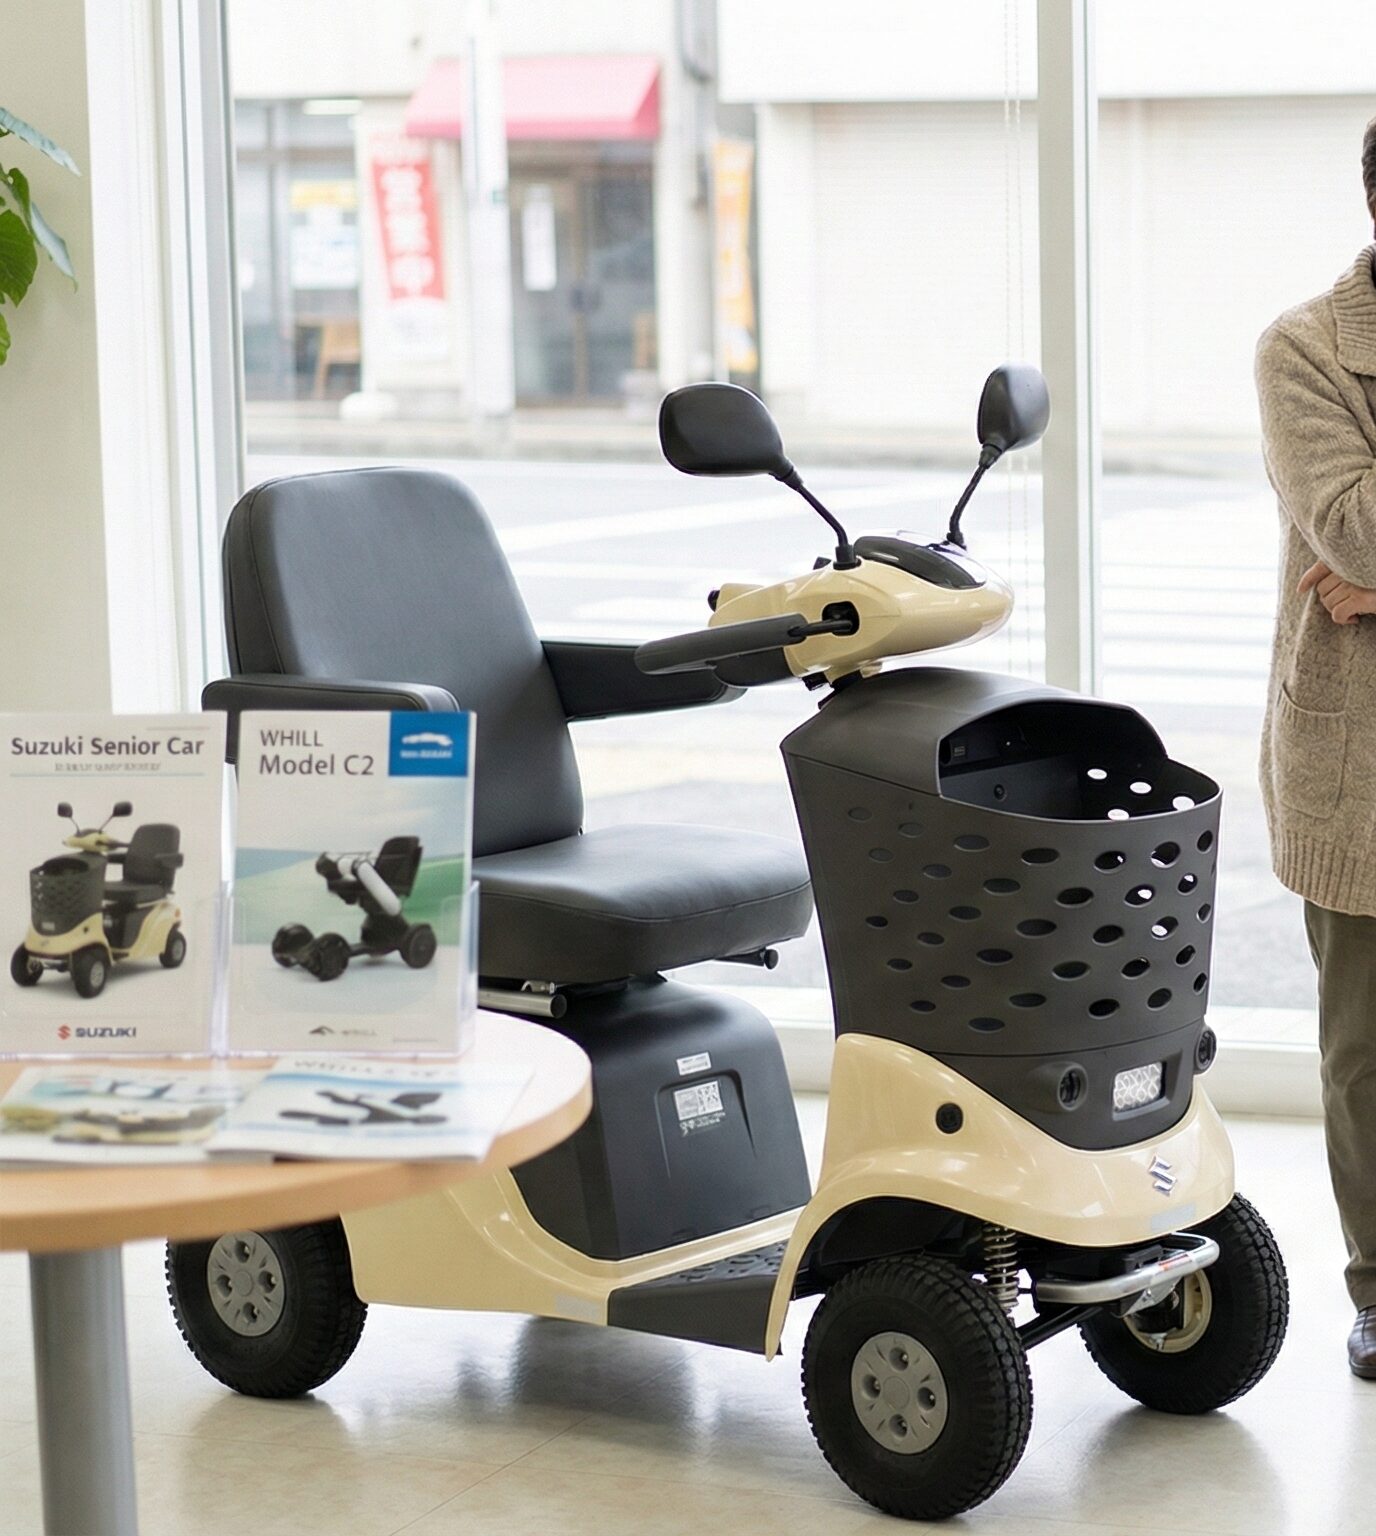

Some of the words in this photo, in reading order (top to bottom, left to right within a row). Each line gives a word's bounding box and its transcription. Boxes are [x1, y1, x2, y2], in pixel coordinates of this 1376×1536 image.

[11, 736, 83, 755] Suzuki
[90, 736, 161, 755] Senior
[166, 737, 205, 755] Car
[260, 730, 323, 747] WHILL
[259, 754, 334, 775] Model
[344, 755, 374, 775] C2
[75, 1027, 137, 1038] SUZUKI
